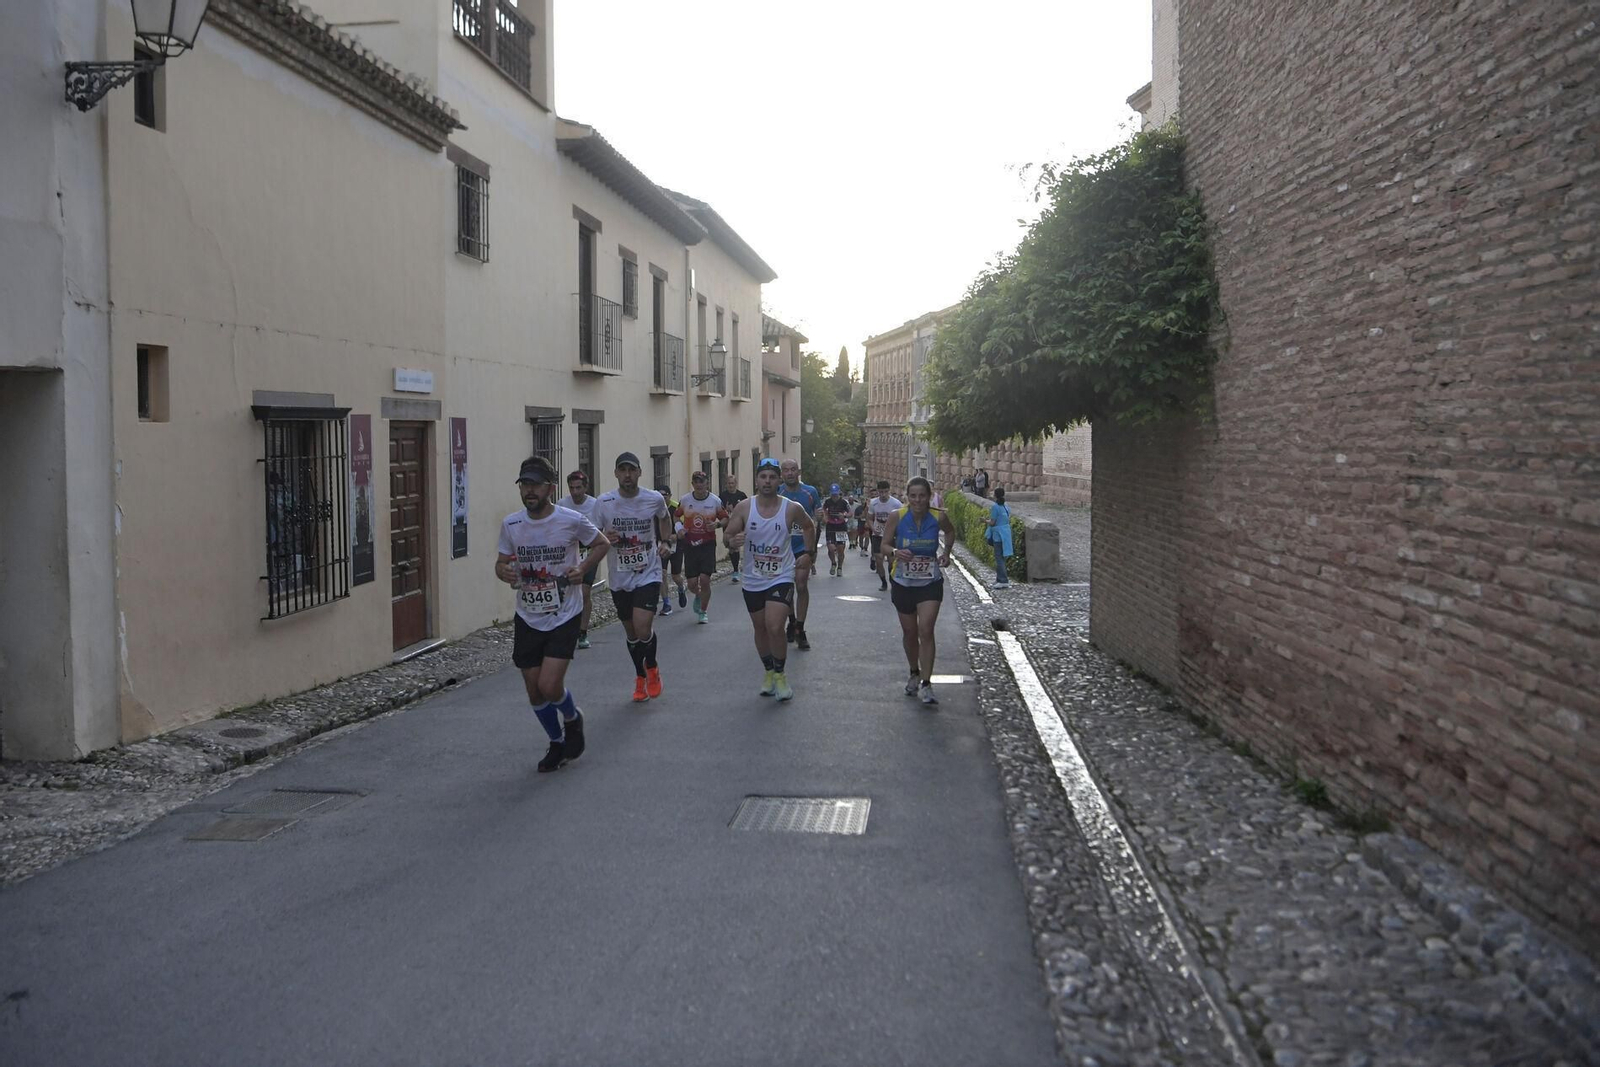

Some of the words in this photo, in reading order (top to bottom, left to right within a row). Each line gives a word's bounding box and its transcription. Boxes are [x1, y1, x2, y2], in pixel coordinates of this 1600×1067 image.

[612, 518, 621, 526] 40
[517, 546, 525, 556] 40
[618, 553, 644, 564] 1836
[754, 560, 778, 571] 3715
[904, 562, 930, 572] 1327
[521, 590, 553, 604] 4346
